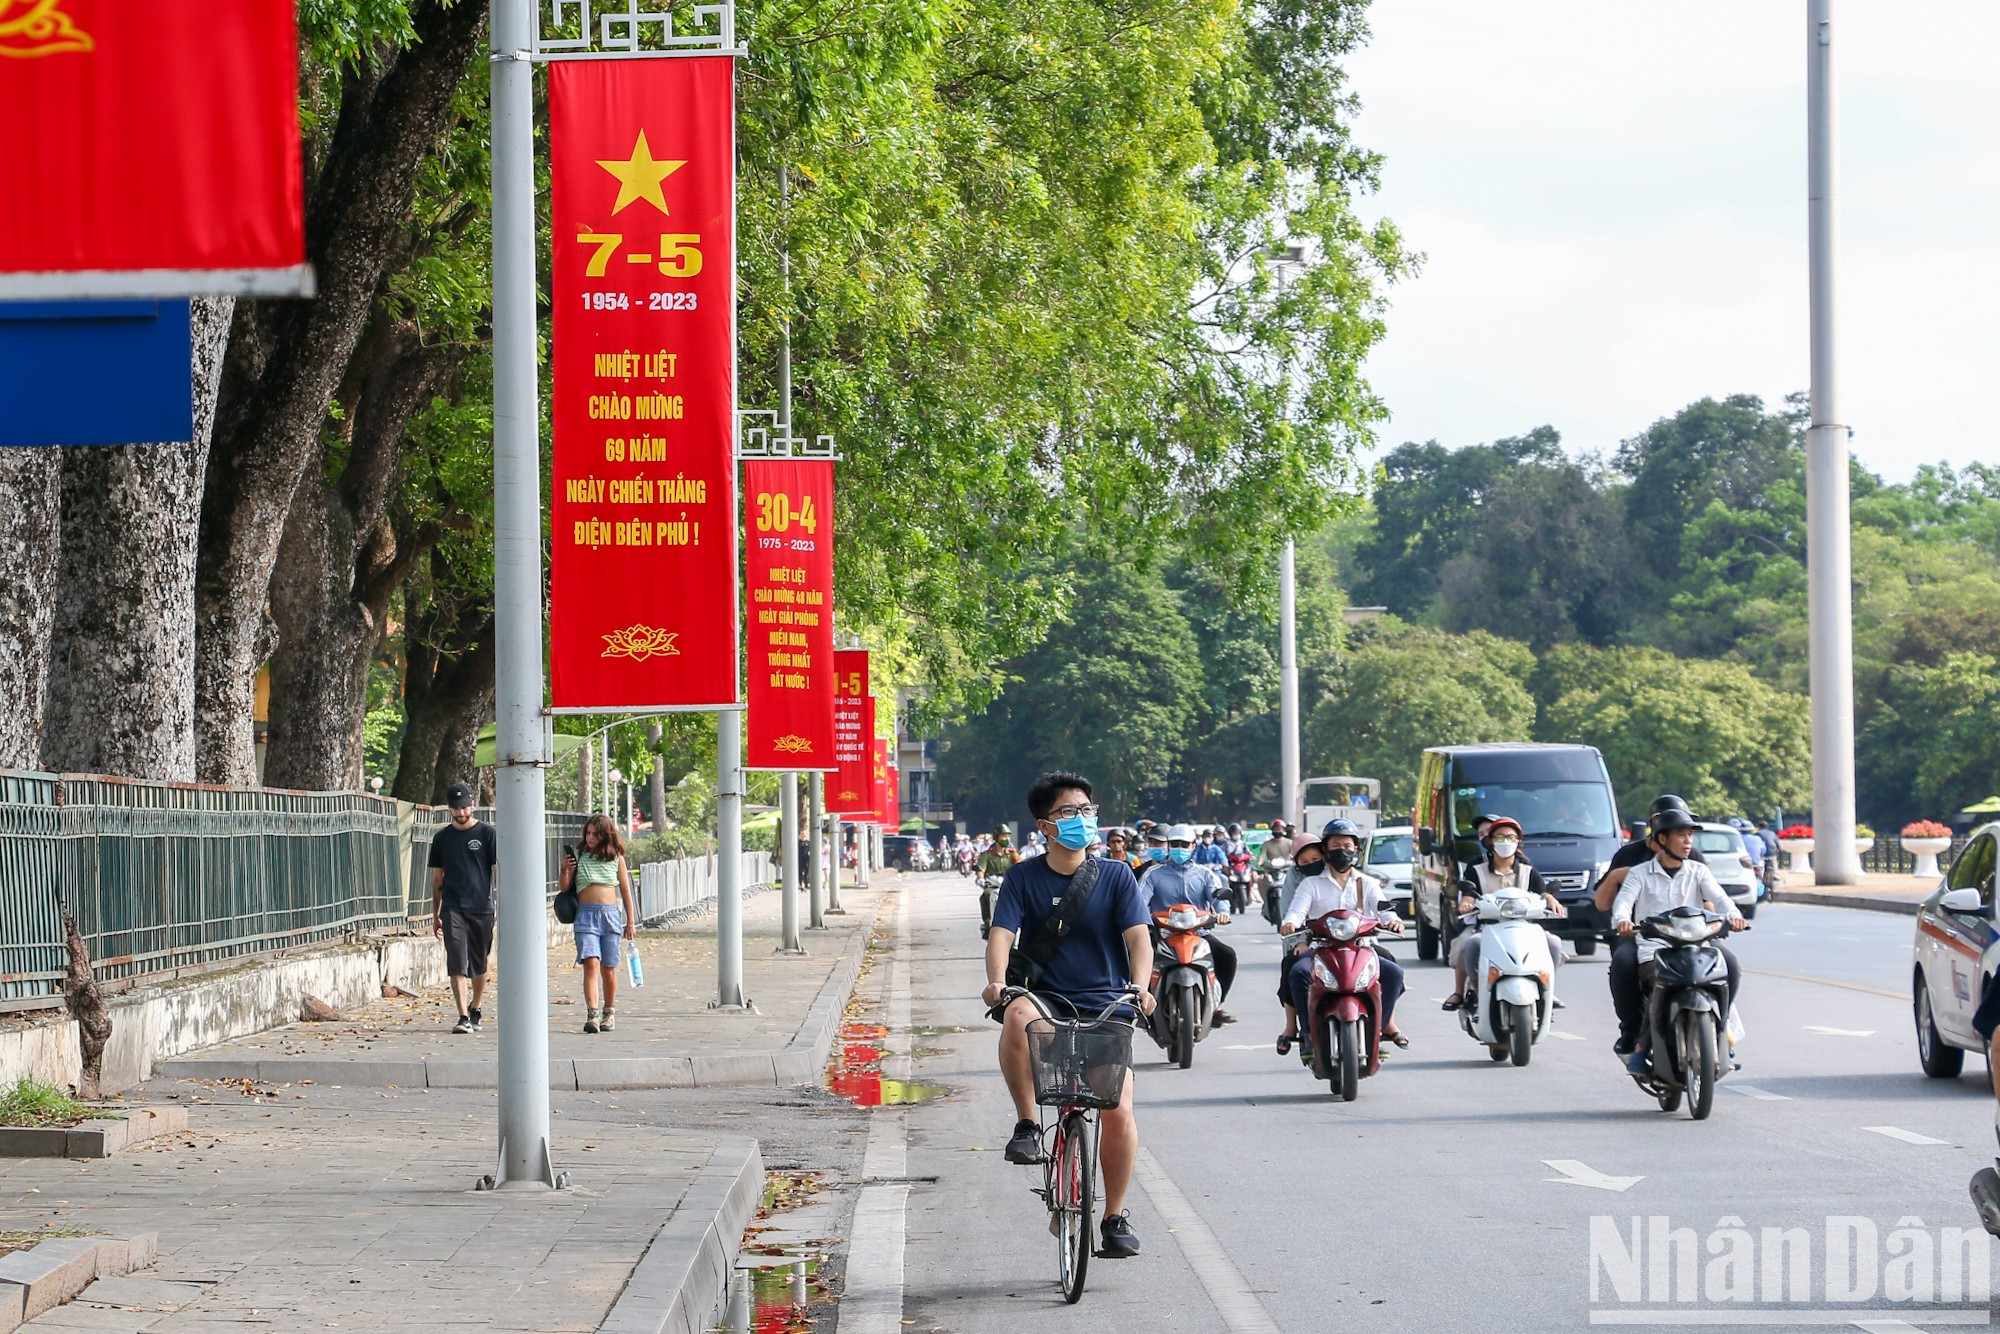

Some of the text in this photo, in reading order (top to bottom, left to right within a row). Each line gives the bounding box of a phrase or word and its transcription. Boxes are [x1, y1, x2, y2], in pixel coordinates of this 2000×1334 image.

[576, 233, 703, 278] 7-5
[581, 292, 629, 310] 1954
[649, 292, 697, 310] 2023
[594, 349, 677, 383] NHIỆT LIỆT
[589, 389, 683, 420] CHÀO MỪNG
[605, 433, 666, 462] 69 NĂM
[566, 472, 706, 503] NGÀY CHIẾN THẮNG
[756, 492, 816, 534] 30-4
[574, 512, 699, 551] ĐIỆN BIÊN PHỦ !
[759, 538, 781, 549] 1975
[790, 539, 814, 552] 2023
[769, 565, 806, 586] NHIỆT LIỆT
[754, 586, 823, 606] CHÀO MỪNG 48 NĂM
[758, 605, 819, 626] NGÀY GIẢI PHÓNG
[789, 632, 809, 649] NAM,
[768, 648, 811, 668] THỐNG NHẤT
[770, 669, 784, 688] ĐẤT
[785, 672, 805, 689] NƯỚC
[834, 672, 861, 696] 1-5
